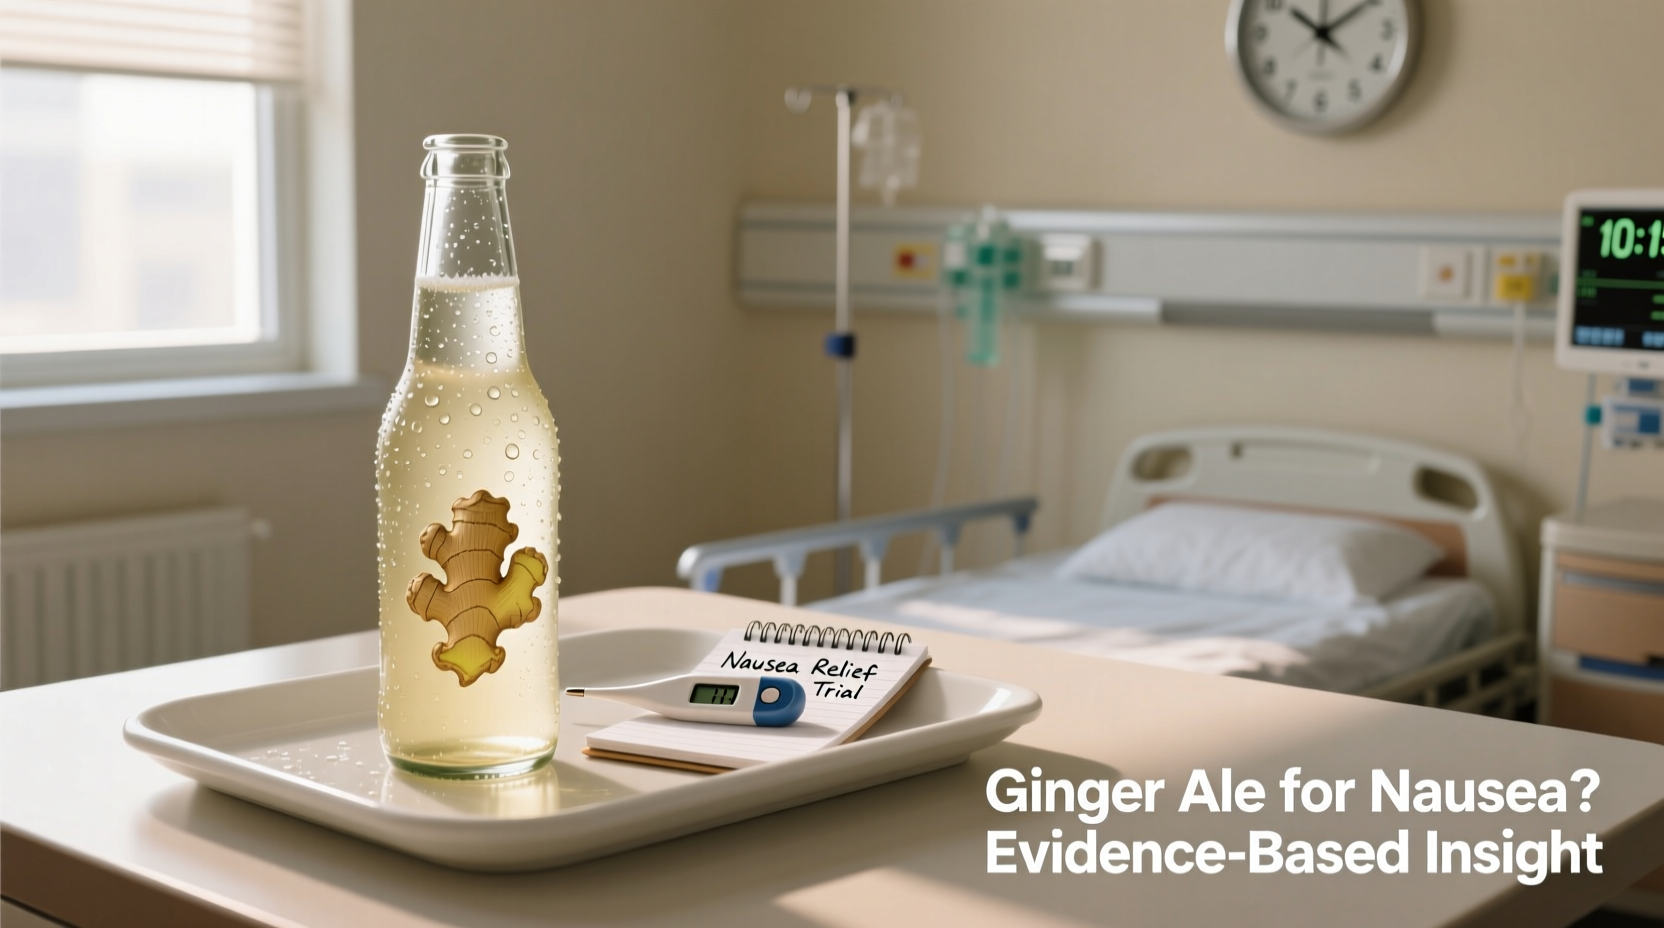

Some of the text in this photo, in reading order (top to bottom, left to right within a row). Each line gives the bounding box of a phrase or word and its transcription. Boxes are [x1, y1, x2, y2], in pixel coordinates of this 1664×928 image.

[1600, 218, 1664, 259] 10:1
[720, 651, 878, 682] Nausea Relief
[813, 681, 864, 700] Trial
